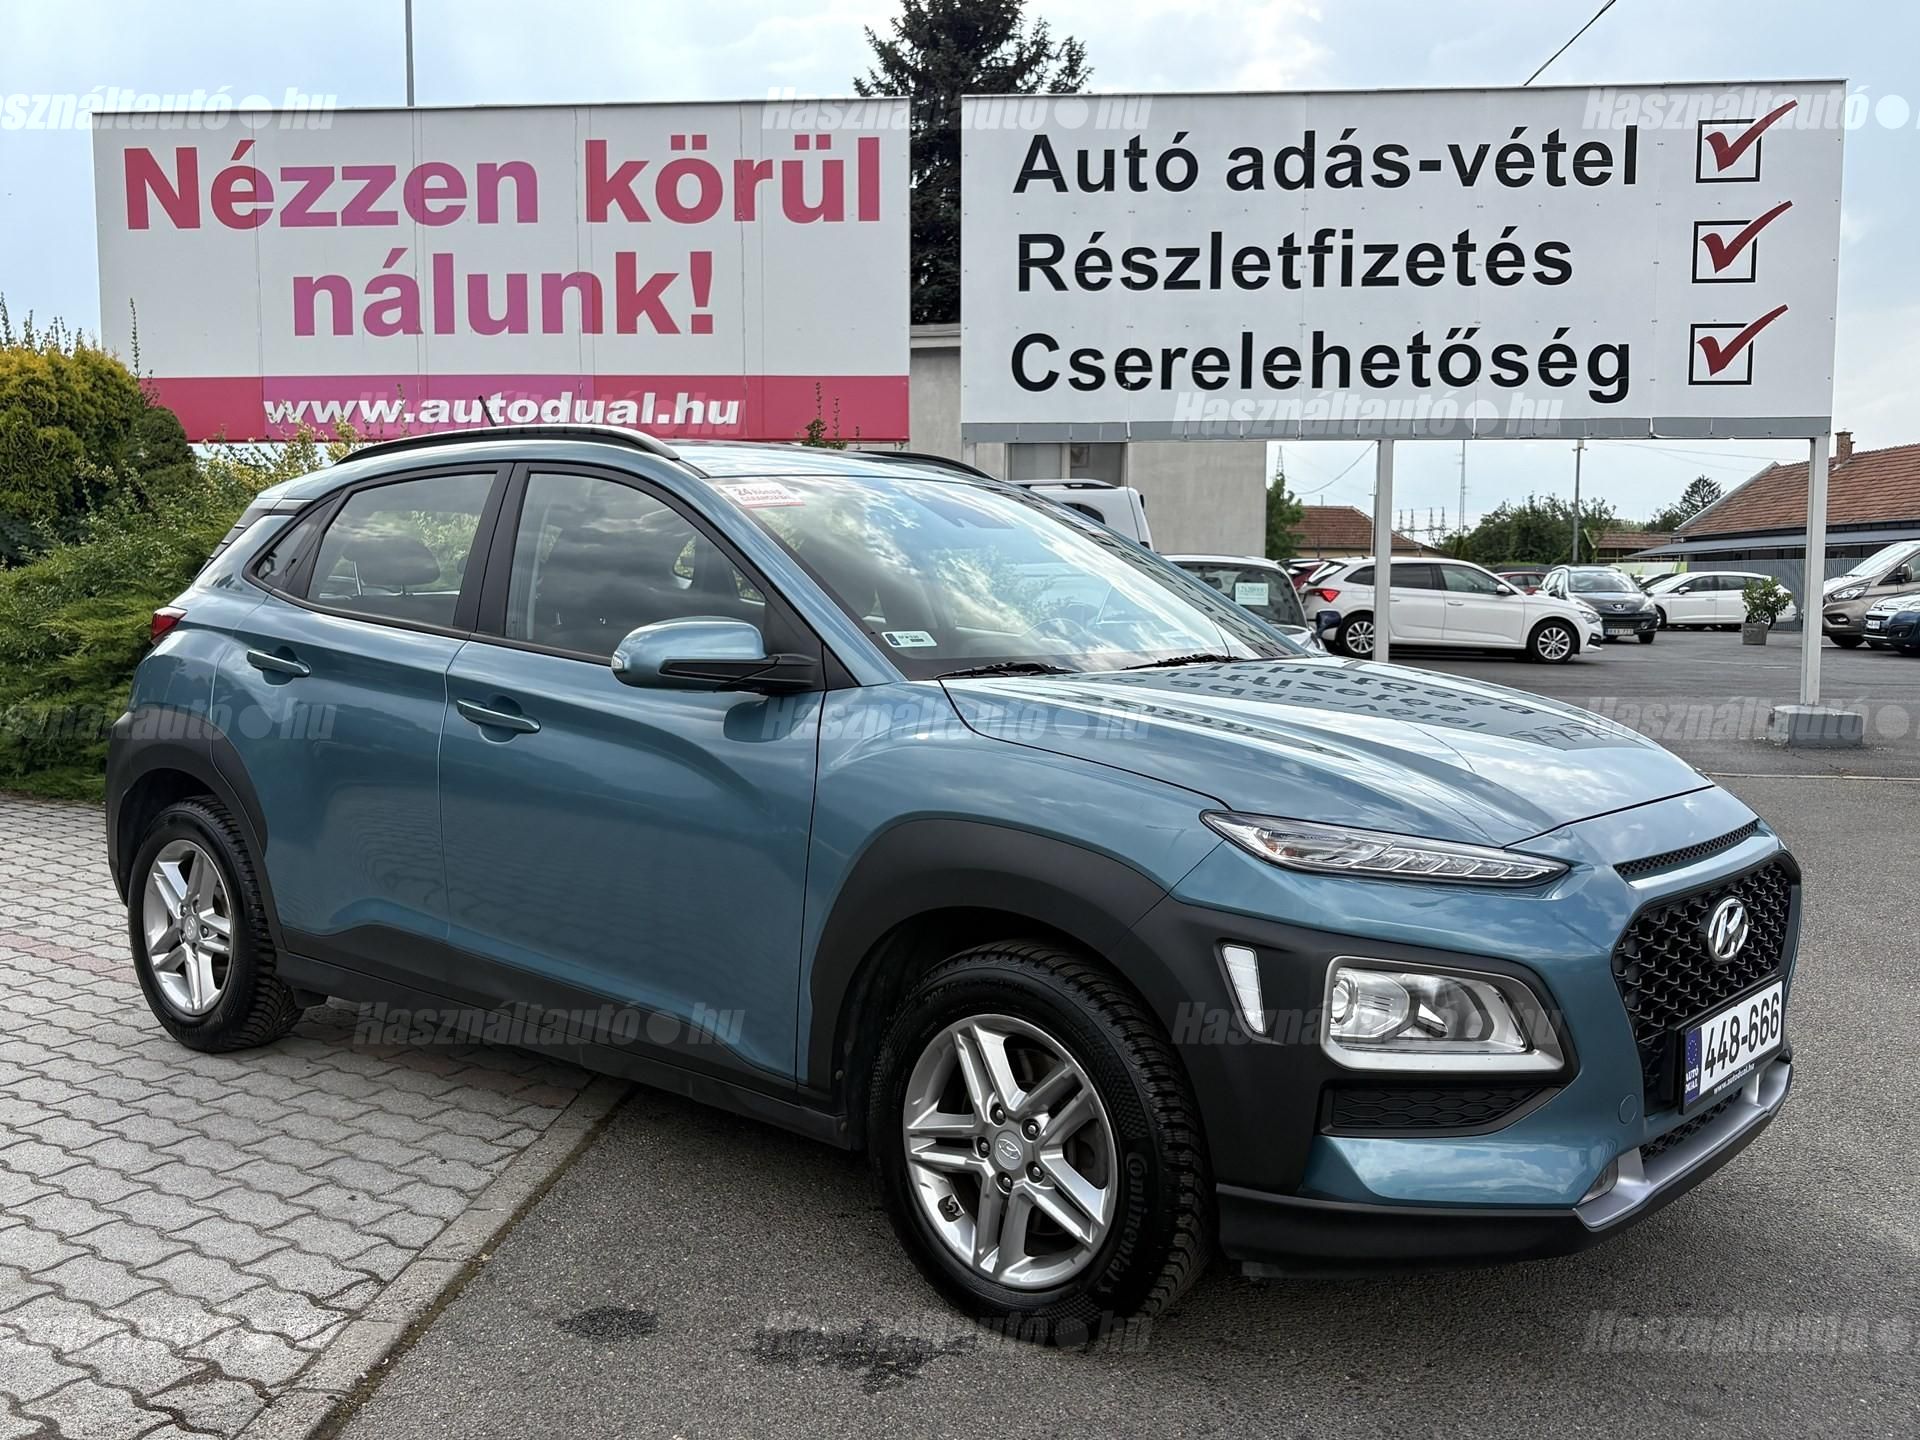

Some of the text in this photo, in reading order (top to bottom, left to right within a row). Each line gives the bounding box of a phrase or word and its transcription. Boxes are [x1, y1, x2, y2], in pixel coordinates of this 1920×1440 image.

[125, 134, 880, 230] Nézzen körül
[1013, 125, 1637, 194] Autó adás-vétel
[293, 248, 713, 336] nálunk!
[1018, 225, 1573, 292] Részletfizetés
[1011, 327, 1630, 404] Cserelehetőség
[264, 392, 739, 426] www.autodual.hu
[1704, 991, 1780, 1078] 448-666
